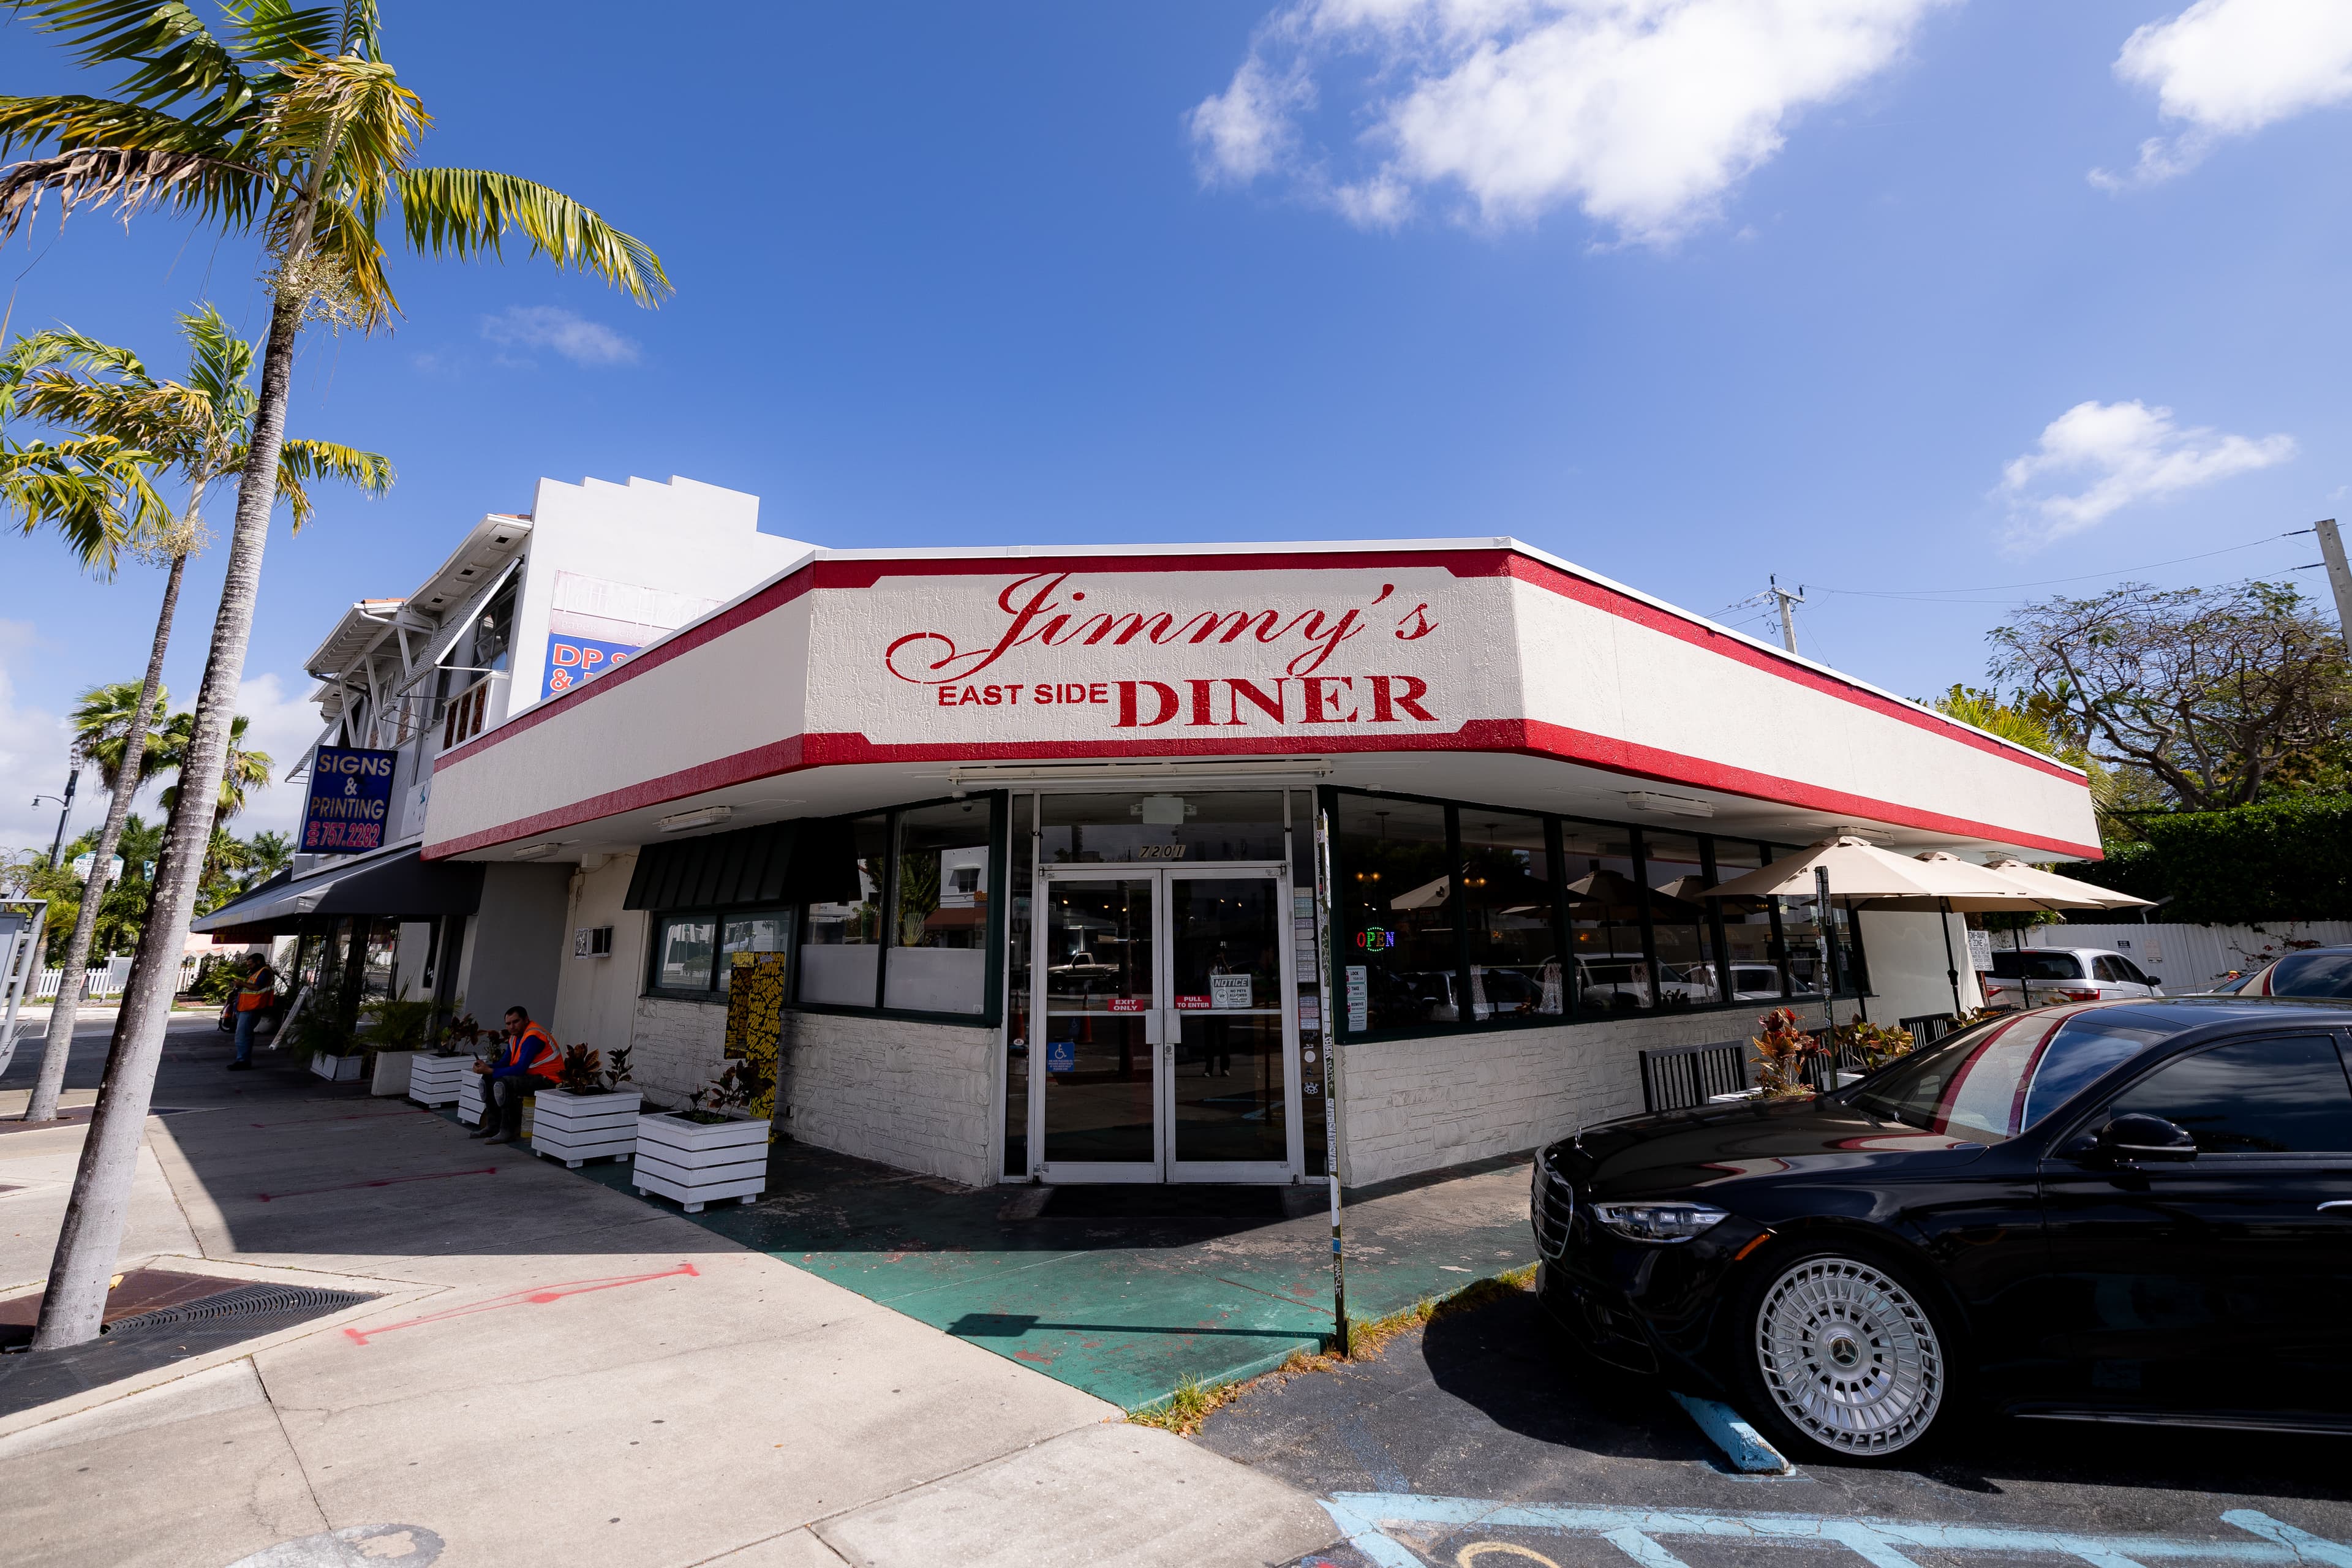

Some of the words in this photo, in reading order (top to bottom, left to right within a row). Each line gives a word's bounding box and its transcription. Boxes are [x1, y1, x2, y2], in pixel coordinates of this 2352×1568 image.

[886, 573, 1439, 684] Jimmy's
[552, 643, 604, 670] DP
[937, 684, 1024, 706] EAST
[1033, 682, 1109, 705] SIDE
[1111, 675, 1439, 728] DINER
[317, 754, 391, 777] SIGNS
[344, 777, 357, 796] &
[309, 796, 385, 820] PRINTING
[320, 821, 380, 848] 757.2282
[1140, 846, 1182, 858] 7201
[1357, 932, 1395, 948] OPEN
